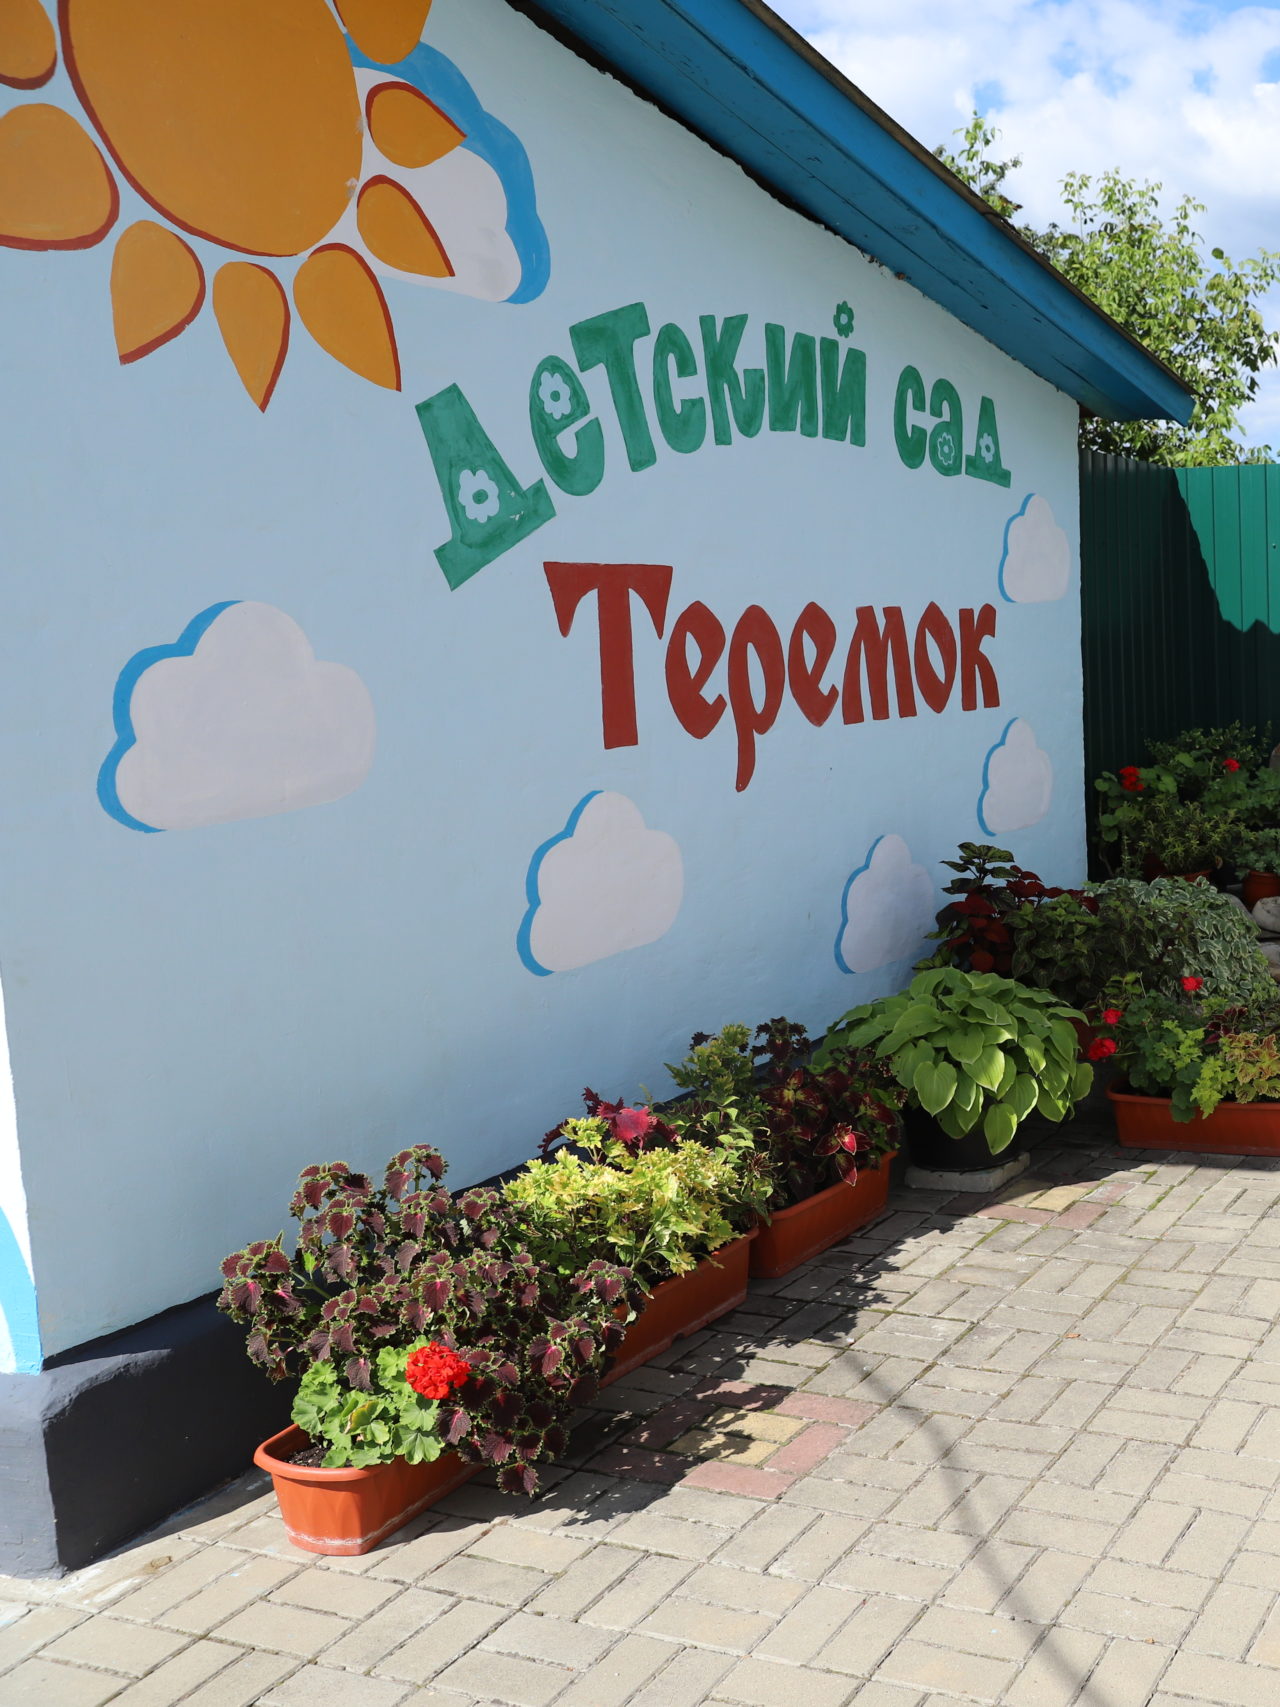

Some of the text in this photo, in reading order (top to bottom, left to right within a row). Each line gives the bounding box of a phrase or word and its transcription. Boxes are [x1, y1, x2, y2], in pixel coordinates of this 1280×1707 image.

[415, 301, 1012, 590] Детский сад
[543, 561, 1001, 793] Теремок
